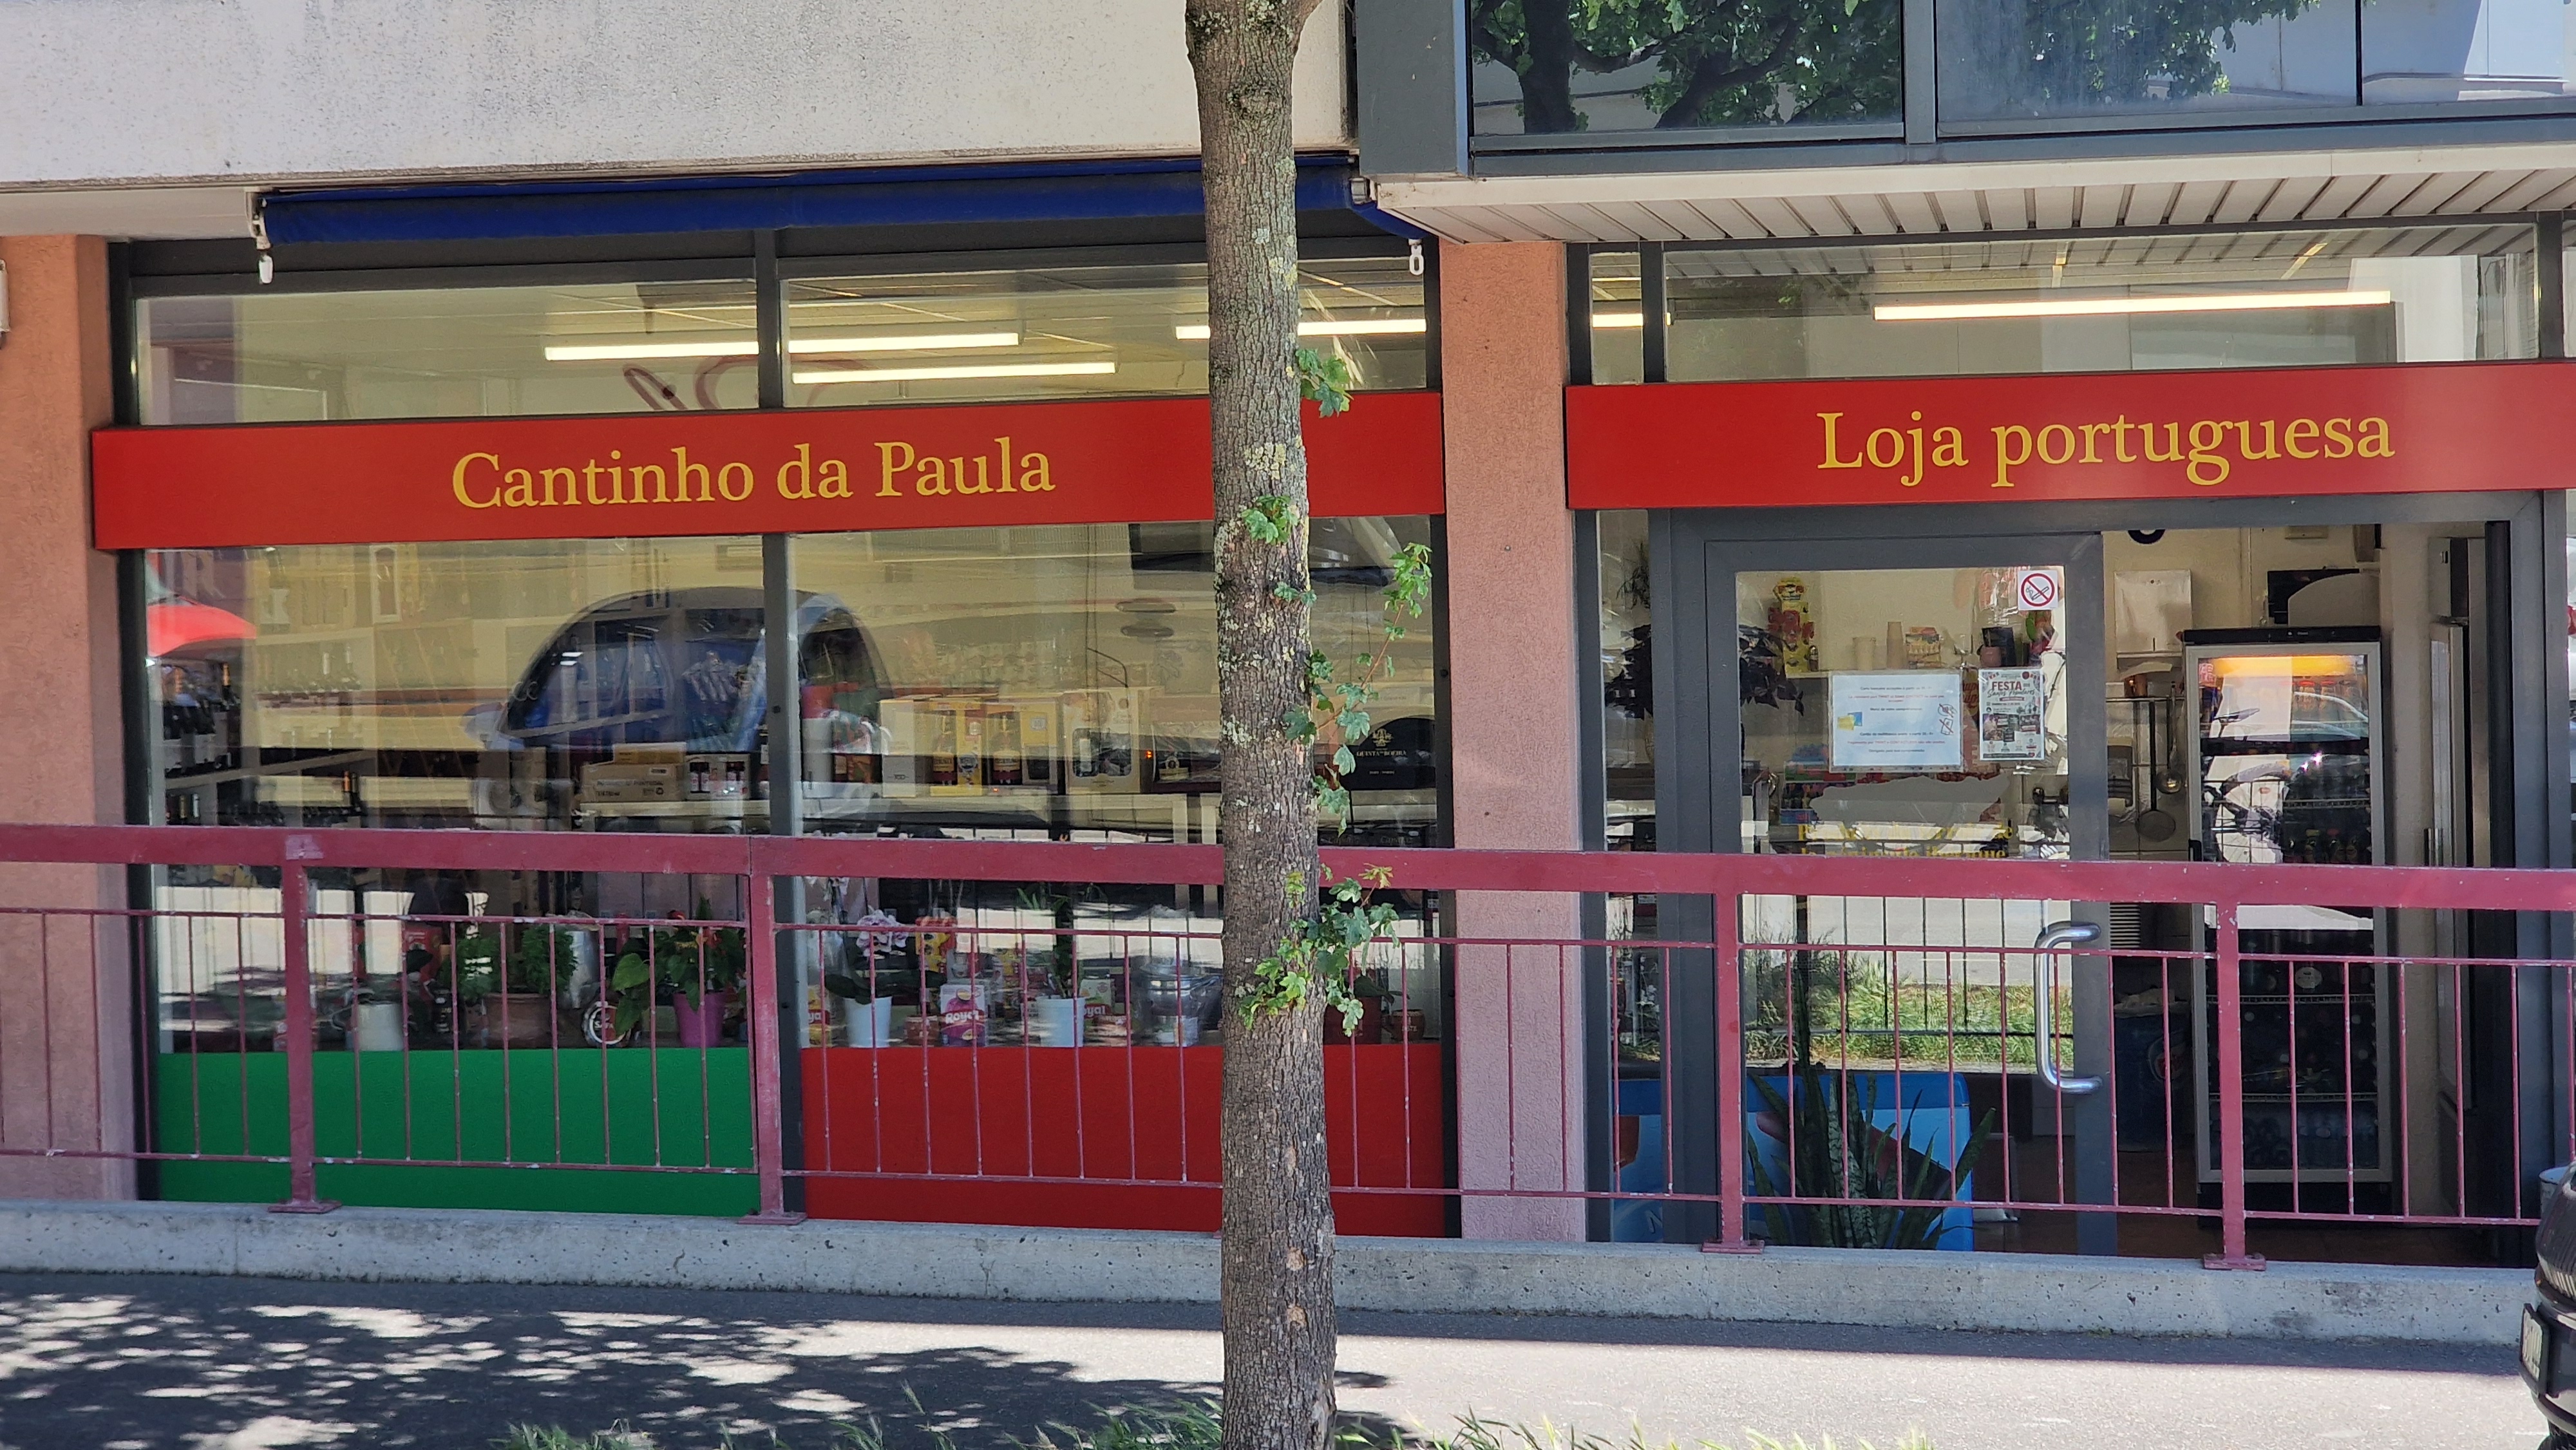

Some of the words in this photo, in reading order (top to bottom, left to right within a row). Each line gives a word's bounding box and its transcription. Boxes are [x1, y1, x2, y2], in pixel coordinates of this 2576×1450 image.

[1817, 411, 1969, 487] Loja
[1990, 414, 2395, 487] portuguesa
[451, 447, 755, 509] Cantinho
[777, 443, 853, 500] da
[876, 437, 1055, 497] Paula
[1992, 681, 2022, 691] FESTA
[1084, 1005, 1106, 1017] yal
